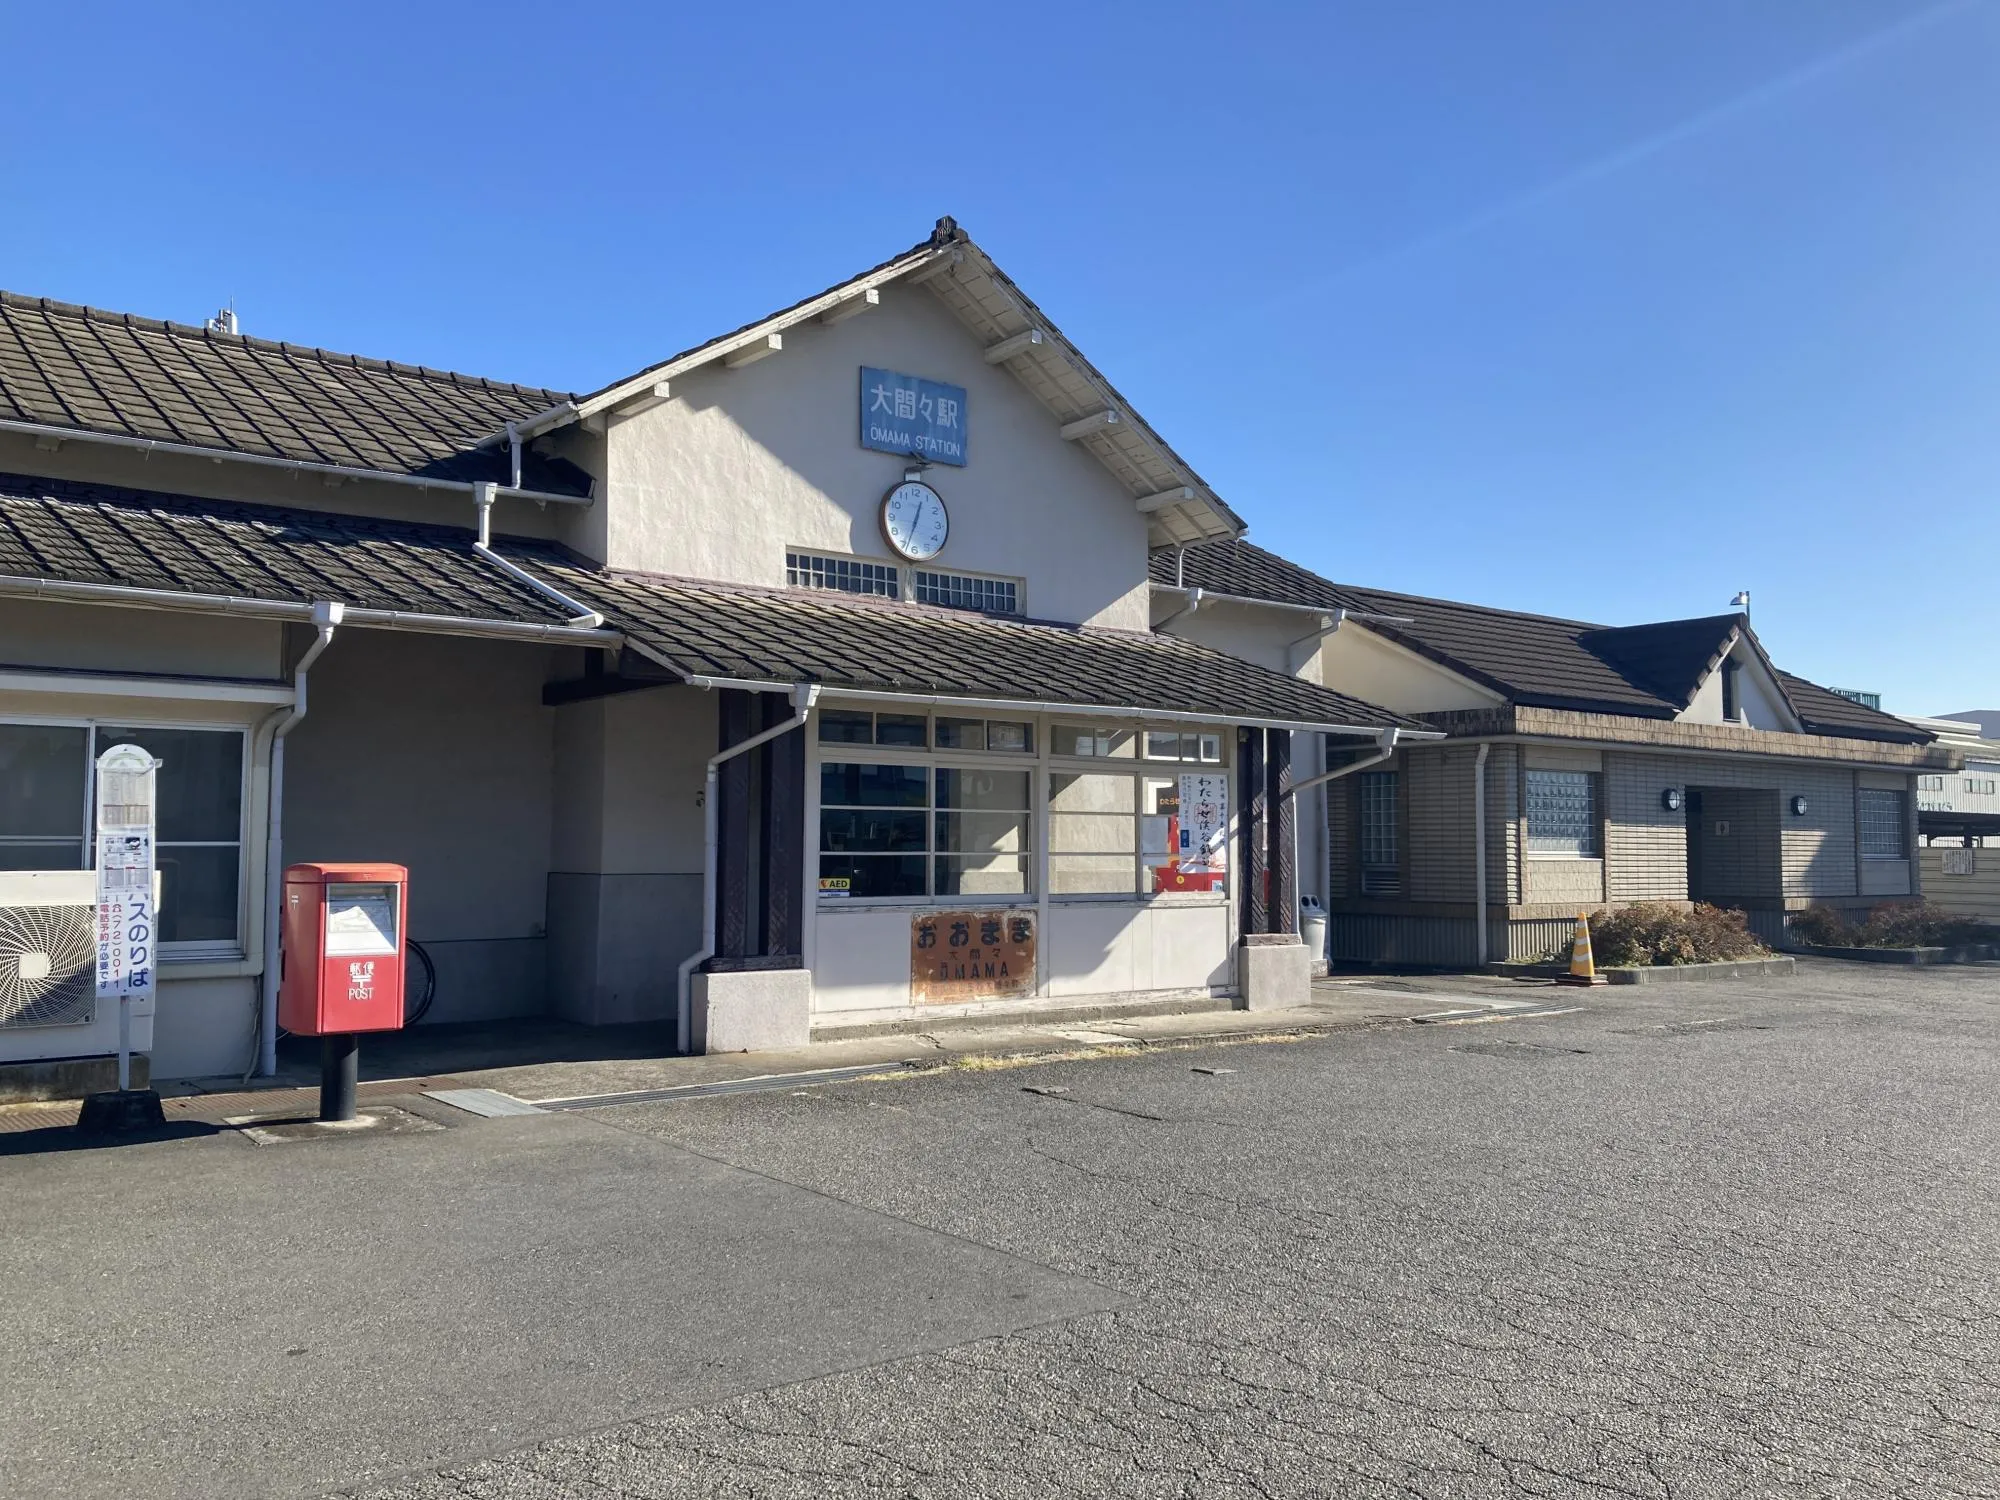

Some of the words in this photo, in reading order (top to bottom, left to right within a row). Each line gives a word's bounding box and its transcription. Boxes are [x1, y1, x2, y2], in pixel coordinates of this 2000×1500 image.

[870, 384, 958, 429] 大間々駅
[915, 435, 961, 457] STATION
[900, 491, 908, 501] 11
[911, 488, 921, 497] 12
[891, 501, 901, 509] 10
[932, 507, 939, 515] 2
[888, 513, 895, 521] 9
[892, 527, 898, 535] 8
[931, 534, 938, 542] 4
[900, 540, 906, 548] 7
[924, 543, 930, 552] 5
[911, 546, 918, 554] 6
[829, 880, 848, 888] AED
[917, 917, 1031, 949] おおまま
[349, 961, 375, 976] 郵便
[348, 987, 374, 1001] POST
